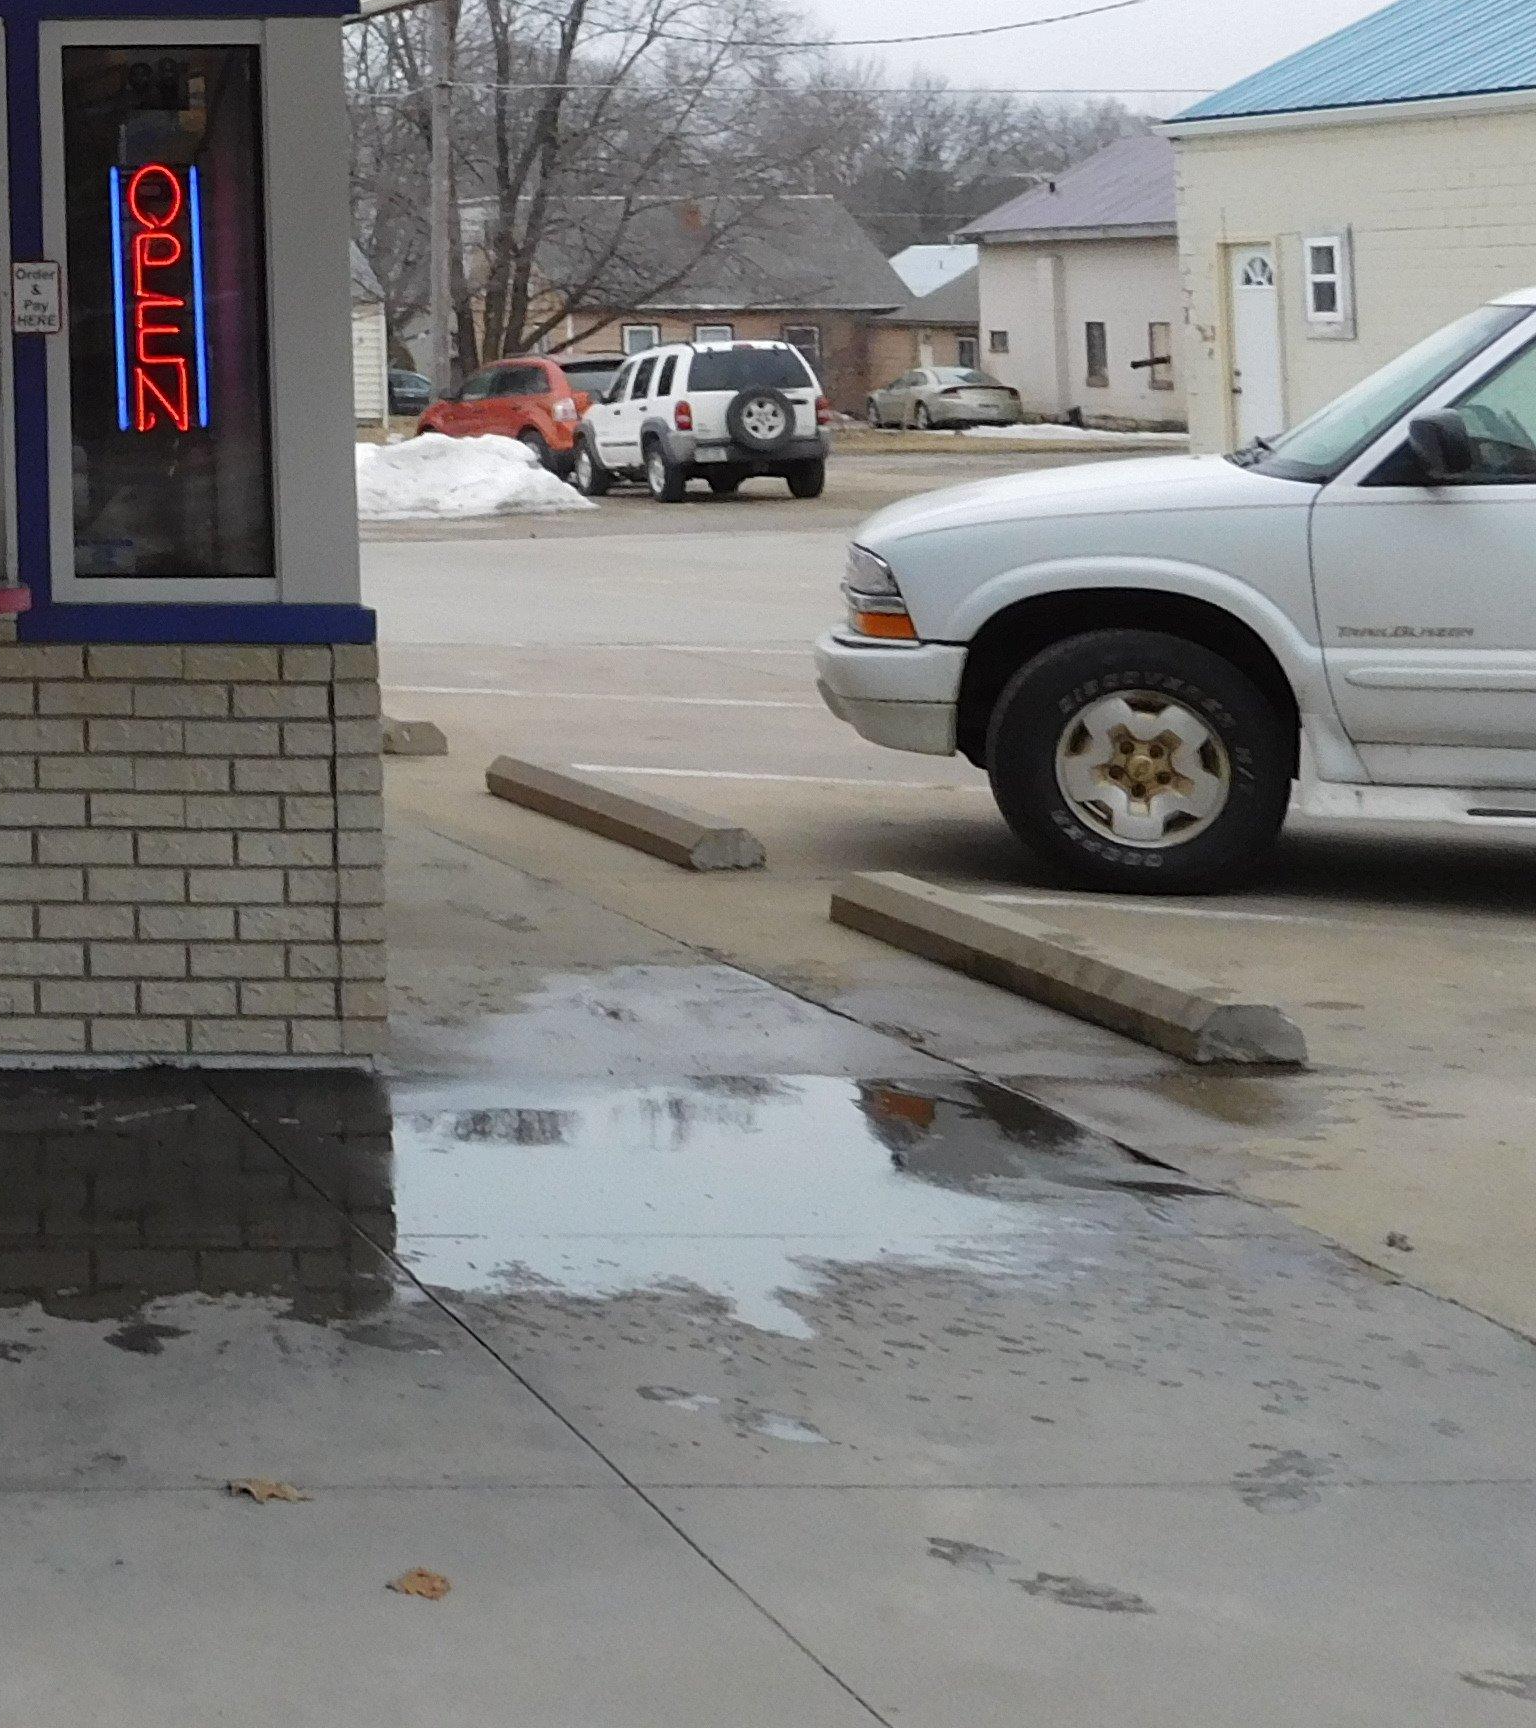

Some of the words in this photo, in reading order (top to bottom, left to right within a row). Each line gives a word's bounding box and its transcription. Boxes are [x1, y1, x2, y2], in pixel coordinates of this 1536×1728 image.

[16, 268, 55, 280] Order
[31, 284, 41, 295] &
[129, 164, 189, 433] OPEN
[24, 299, 49, 313] Pay
[17, 314, 55, 326] HERE
